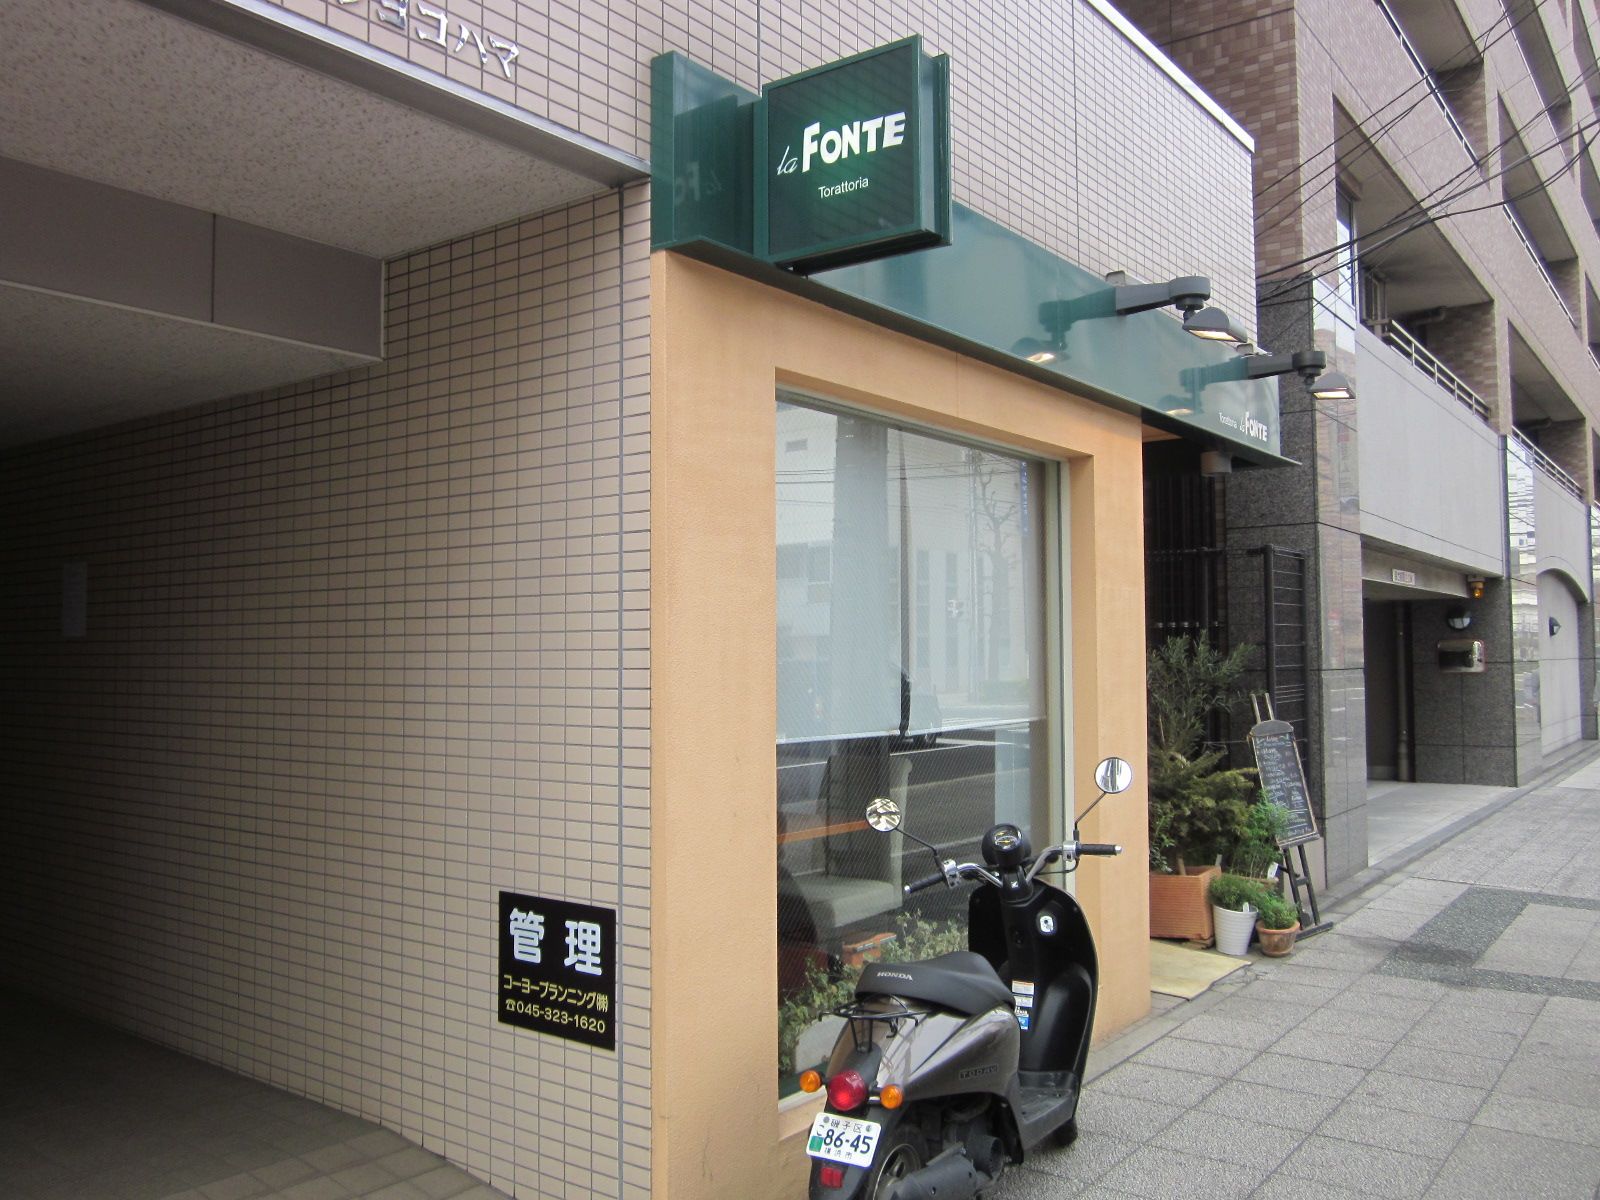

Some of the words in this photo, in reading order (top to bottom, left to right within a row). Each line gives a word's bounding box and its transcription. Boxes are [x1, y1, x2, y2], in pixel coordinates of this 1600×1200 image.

[338, 0, 520, 78] ヨコハマ
[777, 145, 798, 175] la
[802, 112, 906, 173] FONTE
[818, 176, 869, 199] Torattoria
[1245, 411, 1268, 442] FONTE
[509, 907, 603, 976] 管理
[877, 971, 914, 981] HONDA
[823, 1128, 873, 1154] 86-45
